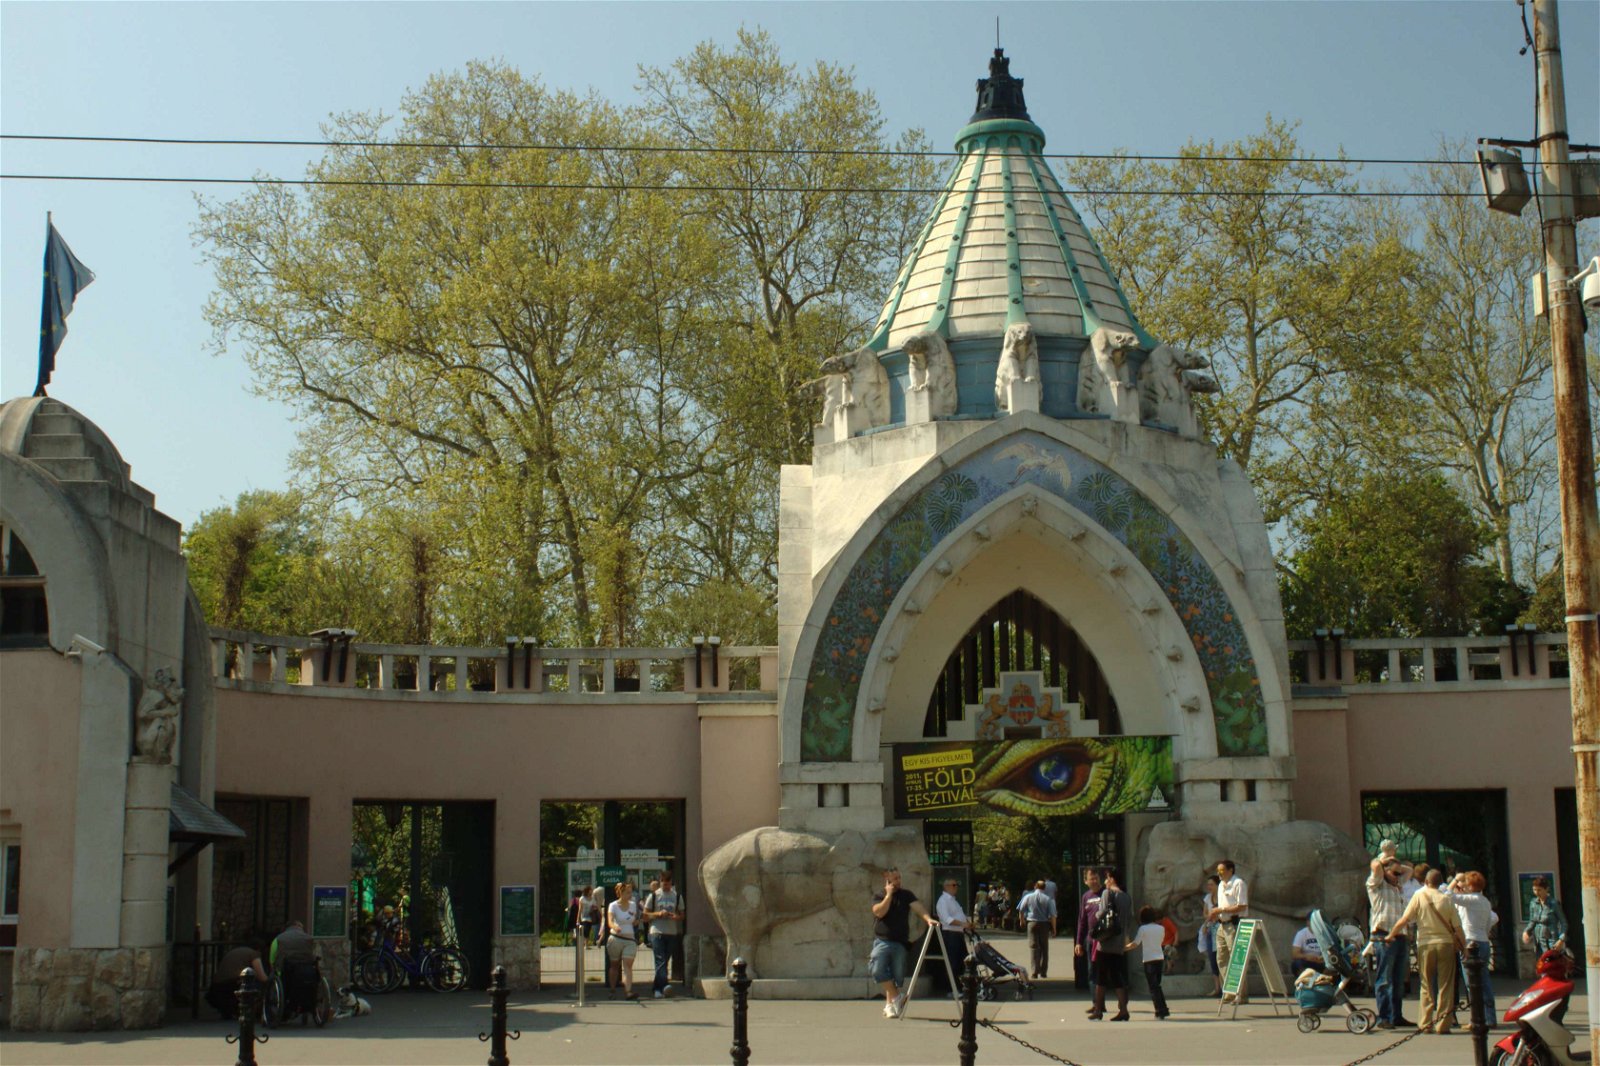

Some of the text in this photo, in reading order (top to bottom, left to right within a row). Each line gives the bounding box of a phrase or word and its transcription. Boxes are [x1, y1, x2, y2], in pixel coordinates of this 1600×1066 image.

[904, 759, 918, 767] EGY
[919, 757, 930, 765] KIS
[924, 767, 976, 789] FÖLD
[906, 786, 978, 807] FESZTIVÁL
